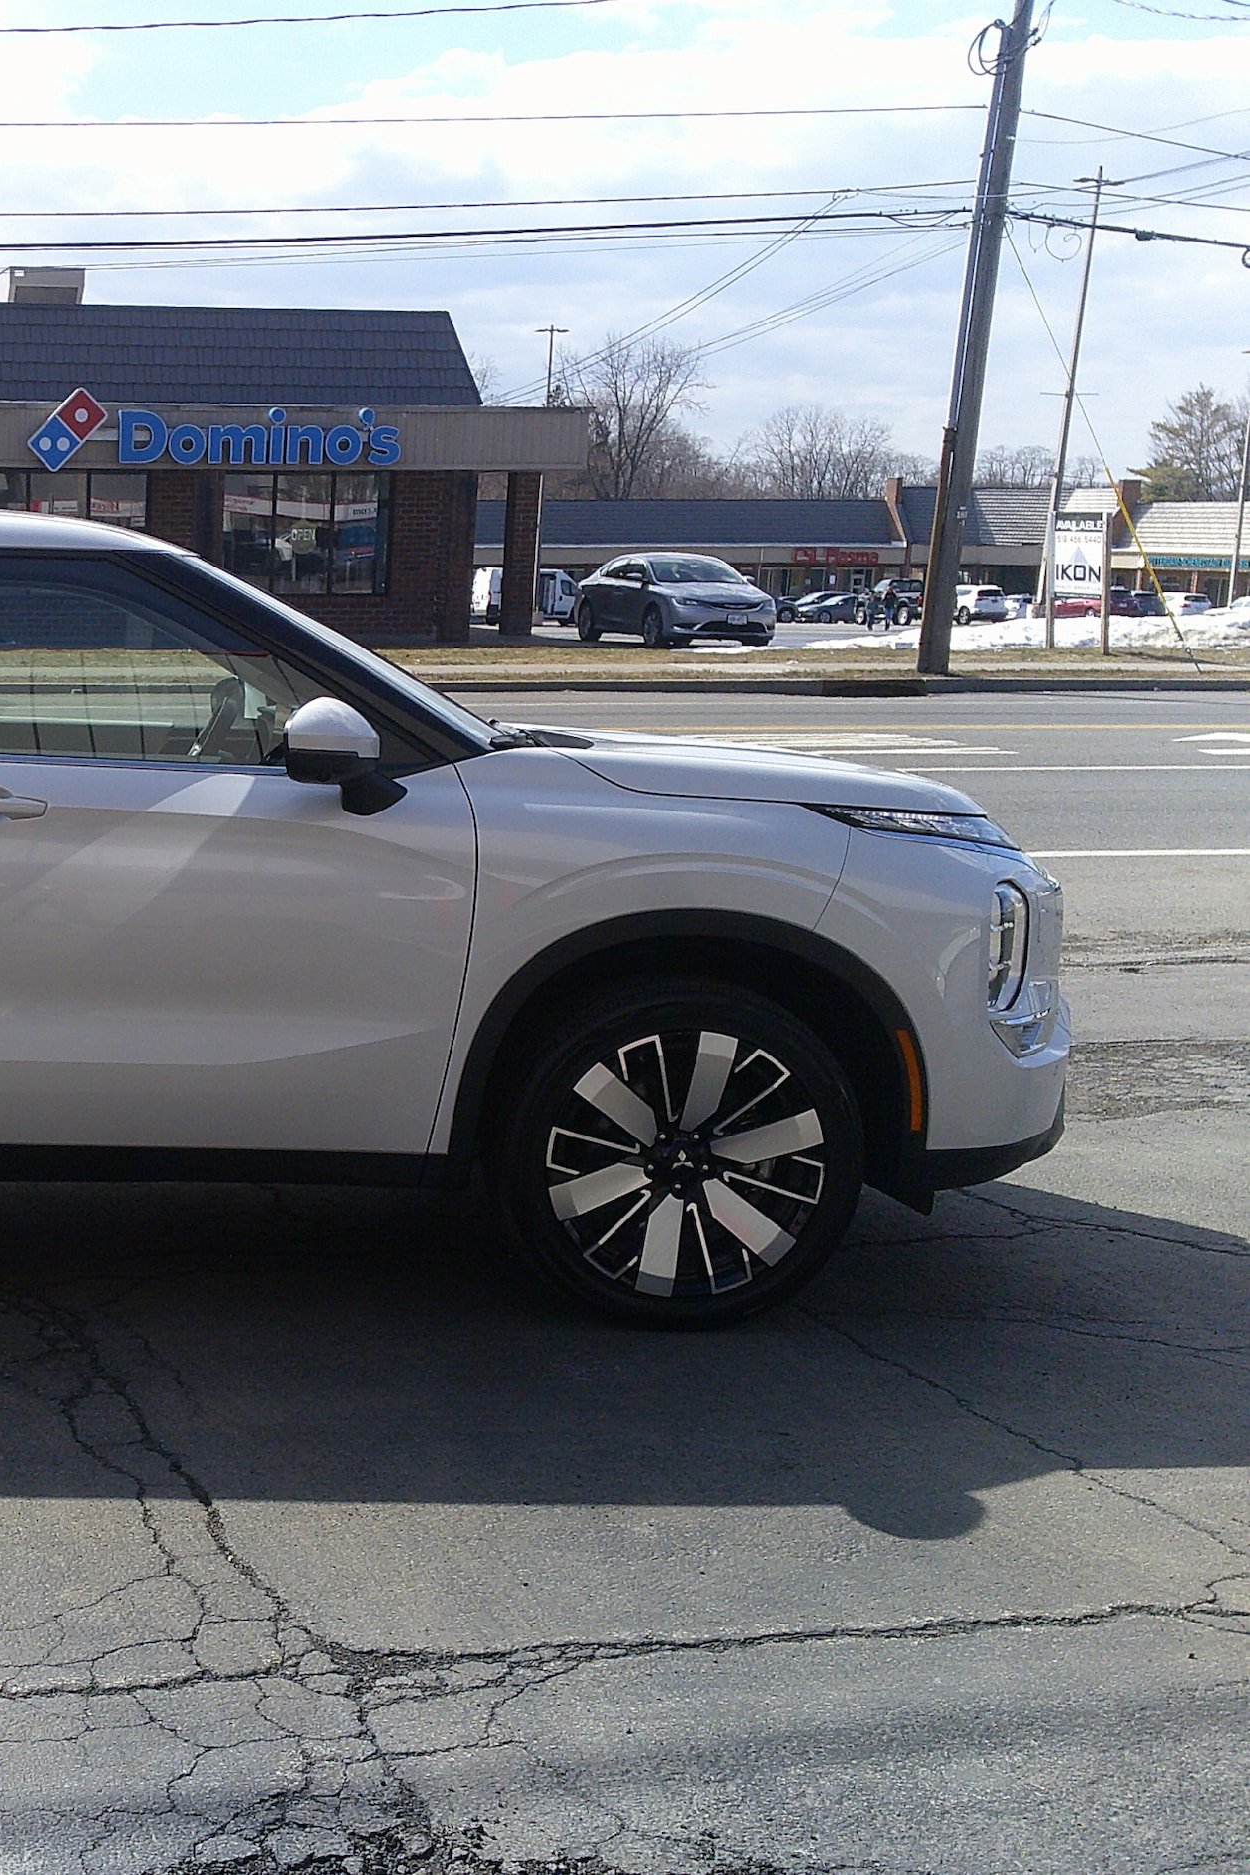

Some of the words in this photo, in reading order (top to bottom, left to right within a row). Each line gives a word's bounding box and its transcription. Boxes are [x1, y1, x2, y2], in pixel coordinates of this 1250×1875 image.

[118, 406, 402, 466] Domino's
[1055, 519, 1104, 531] AVAILABLE
[290, 528, 316, 541] OPEN
[1055, 564, 1101, 583] IKON
